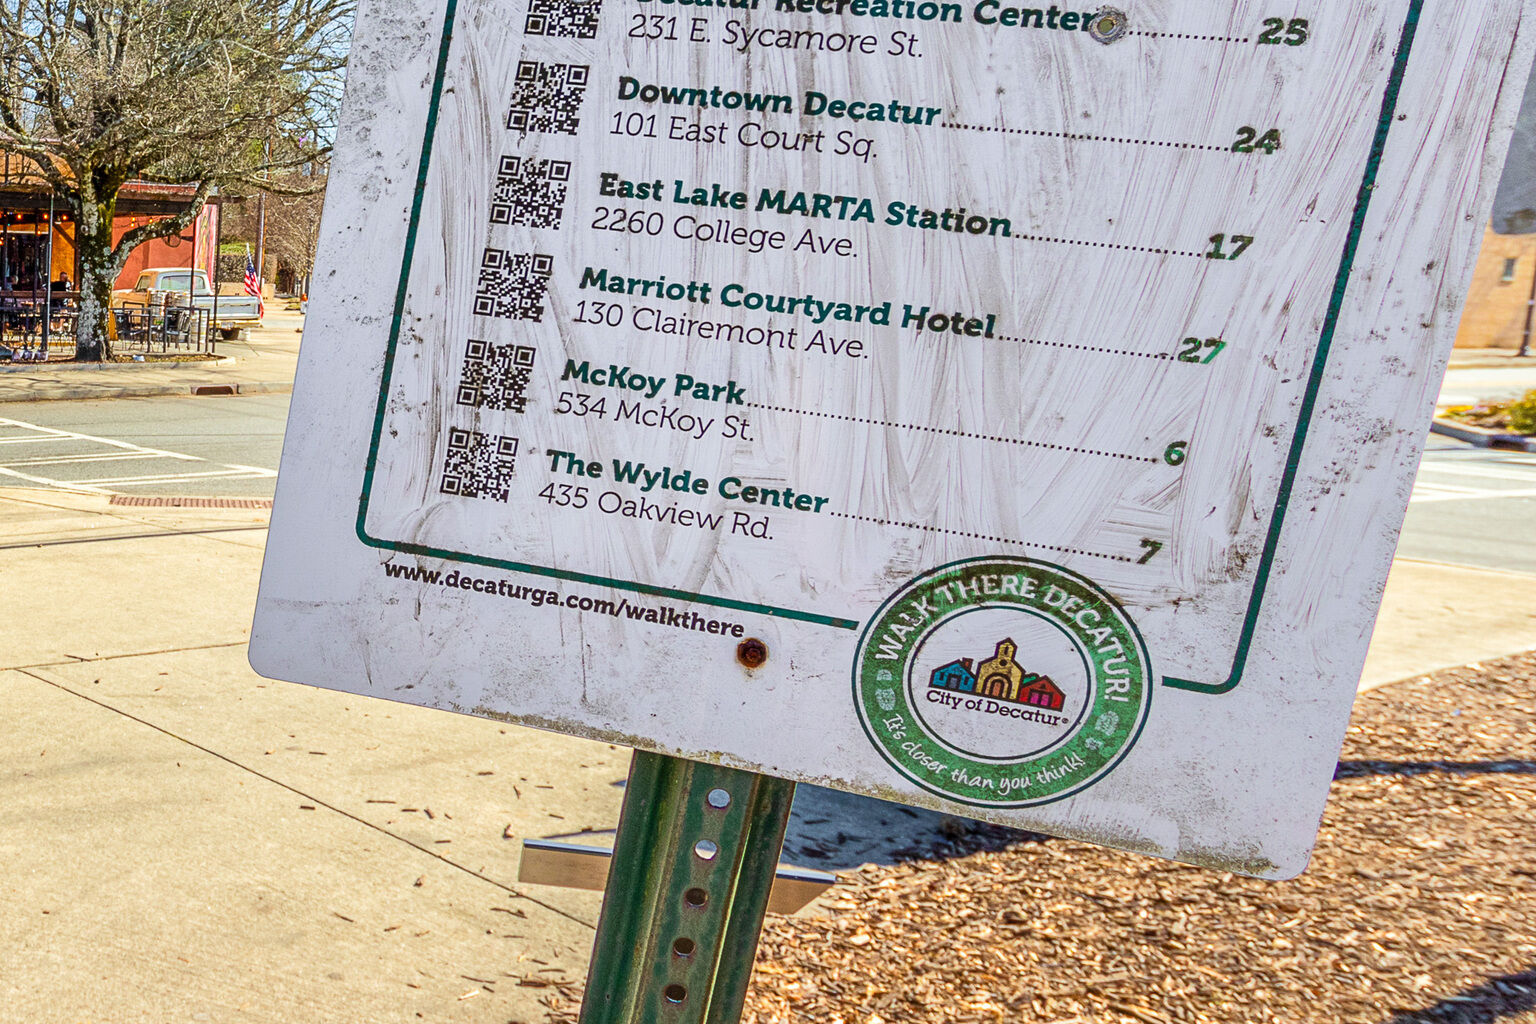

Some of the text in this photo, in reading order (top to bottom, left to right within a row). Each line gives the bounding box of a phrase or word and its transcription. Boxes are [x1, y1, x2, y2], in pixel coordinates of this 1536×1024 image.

[627, 14, 923, 59] 231 E. Sycamore St.
[1257, 17, 1309, 46] 25
[609, 112, 878, 163] 101 East Court Sq.
[618, 76, 1281, 155] Downtown Decatur 24
[590, 208, 858, 258] 2260 College Ave.
[598, 173, 1254, 260] East Lake MARTA Station 17
[573, 302, 869, 360] 130 Clairemont Ave.
[578, 266, 1227, 364] Marriott Courtyard Hotel 27
[557, 393, 755, 442] 534 McKoy St.
[561, 359, 1187, 466] McKoy Park 6
[538, 484, 774, 541] 435 Oakview Rd.
[546, 449, 1163, 564] The Wylde Center 7
[384, 560, 745, 638] www.decaturga.com/walkthere
[875, 574, 1131, 703] WALK THERE DECATUR!
[926, 690, 1060, 726] City of Decatur
[882, 713, 1086, 796] It's closer than you think!
